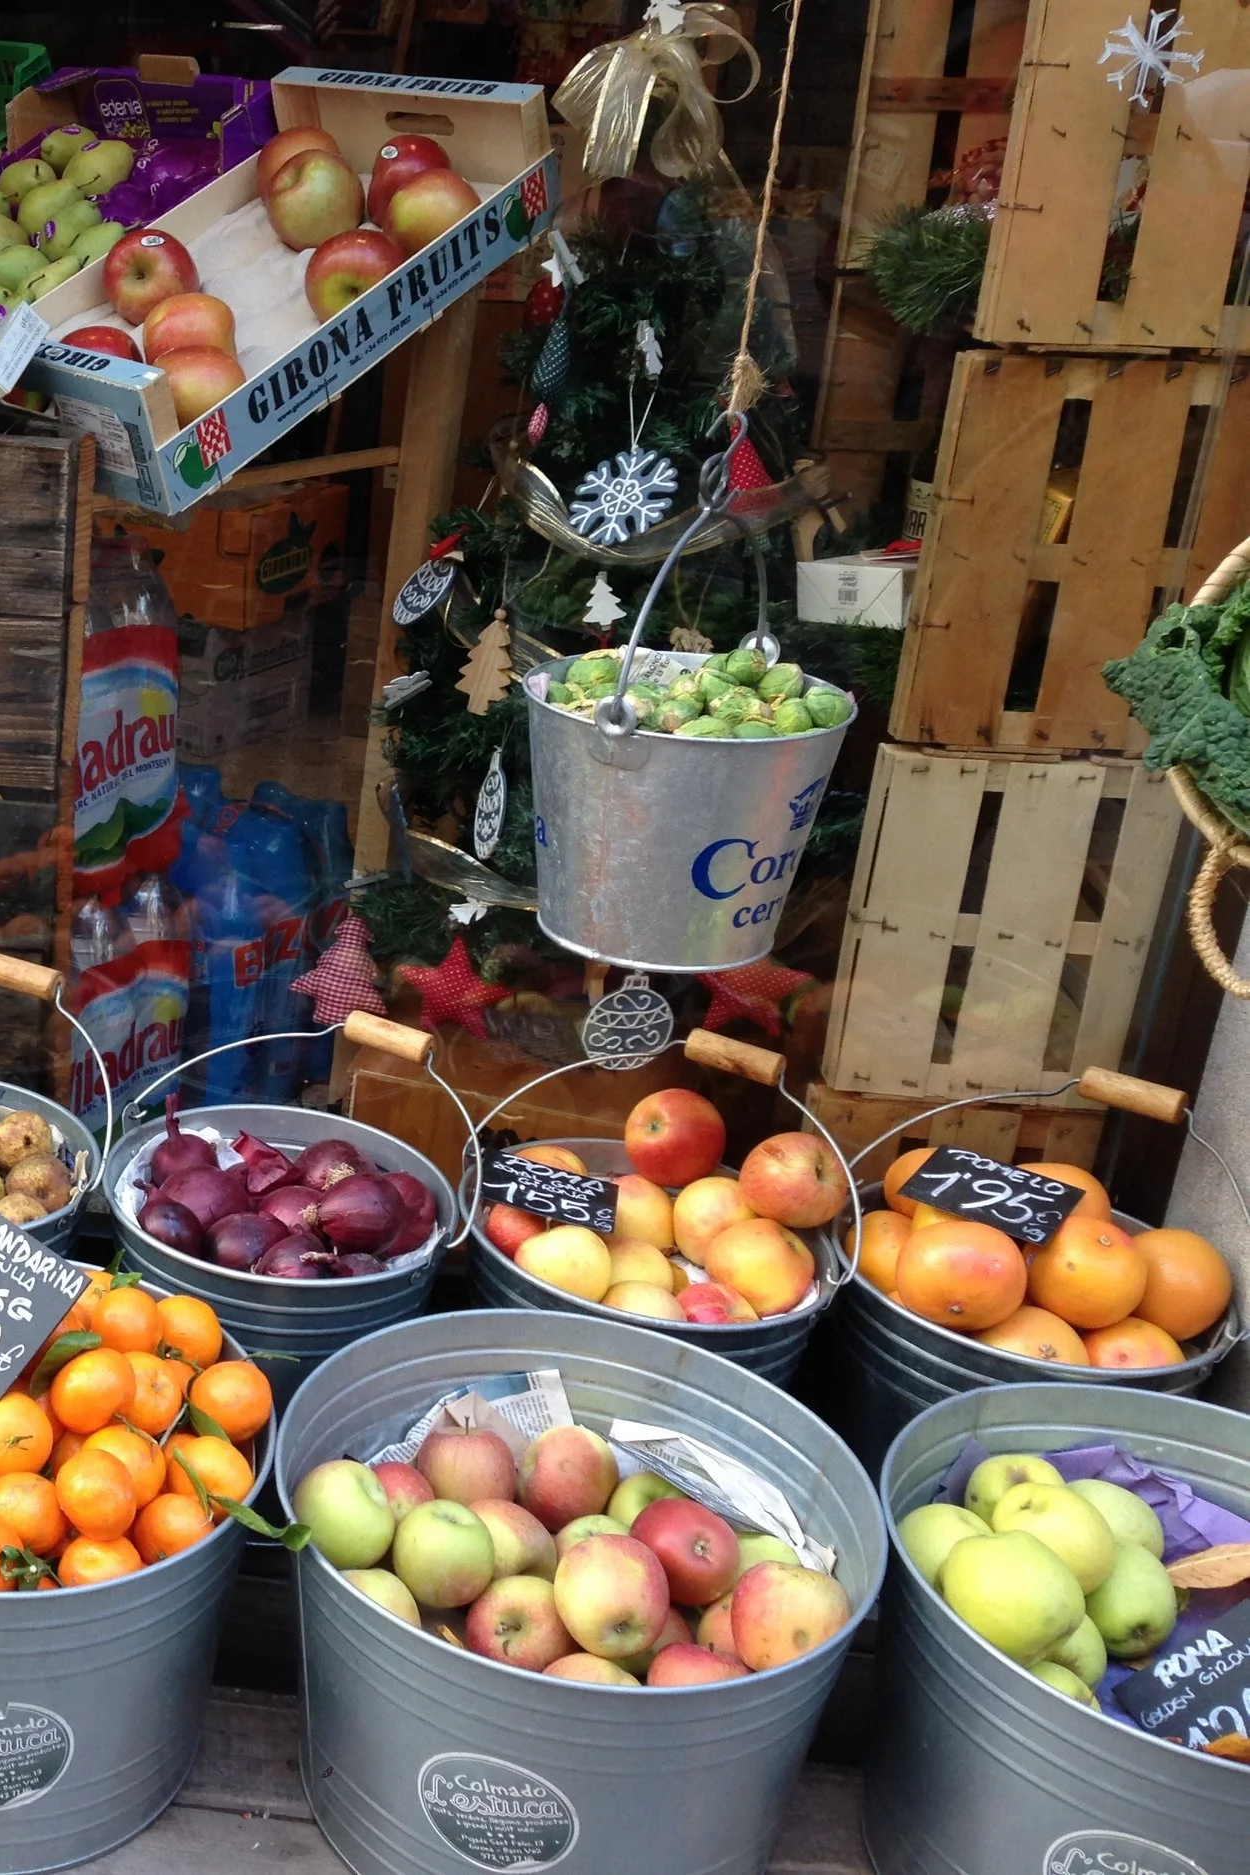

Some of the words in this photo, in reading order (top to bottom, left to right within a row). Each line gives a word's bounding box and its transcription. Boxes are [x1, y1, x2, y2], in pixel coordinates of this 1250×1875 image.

[317, 71, 403, 88] GIRONA
[406, 78, 499, 95] FRUITS
[100, 99, 143, 117] edenia
[248, 306, 374, 424] GIRONA
[387, 205, 500, 320] FRUITS
[502, 1154, 605, 1193] POMA
[551, 1180, 596, 1196] GALA
[947, 1149, 1066, 1196] POMELO
[1154, 1629, 1233, 1688] POMA
[1141, 1686, 1196, 1729] GOLDEN
[454, 1774, 547, 1798] Colmado
